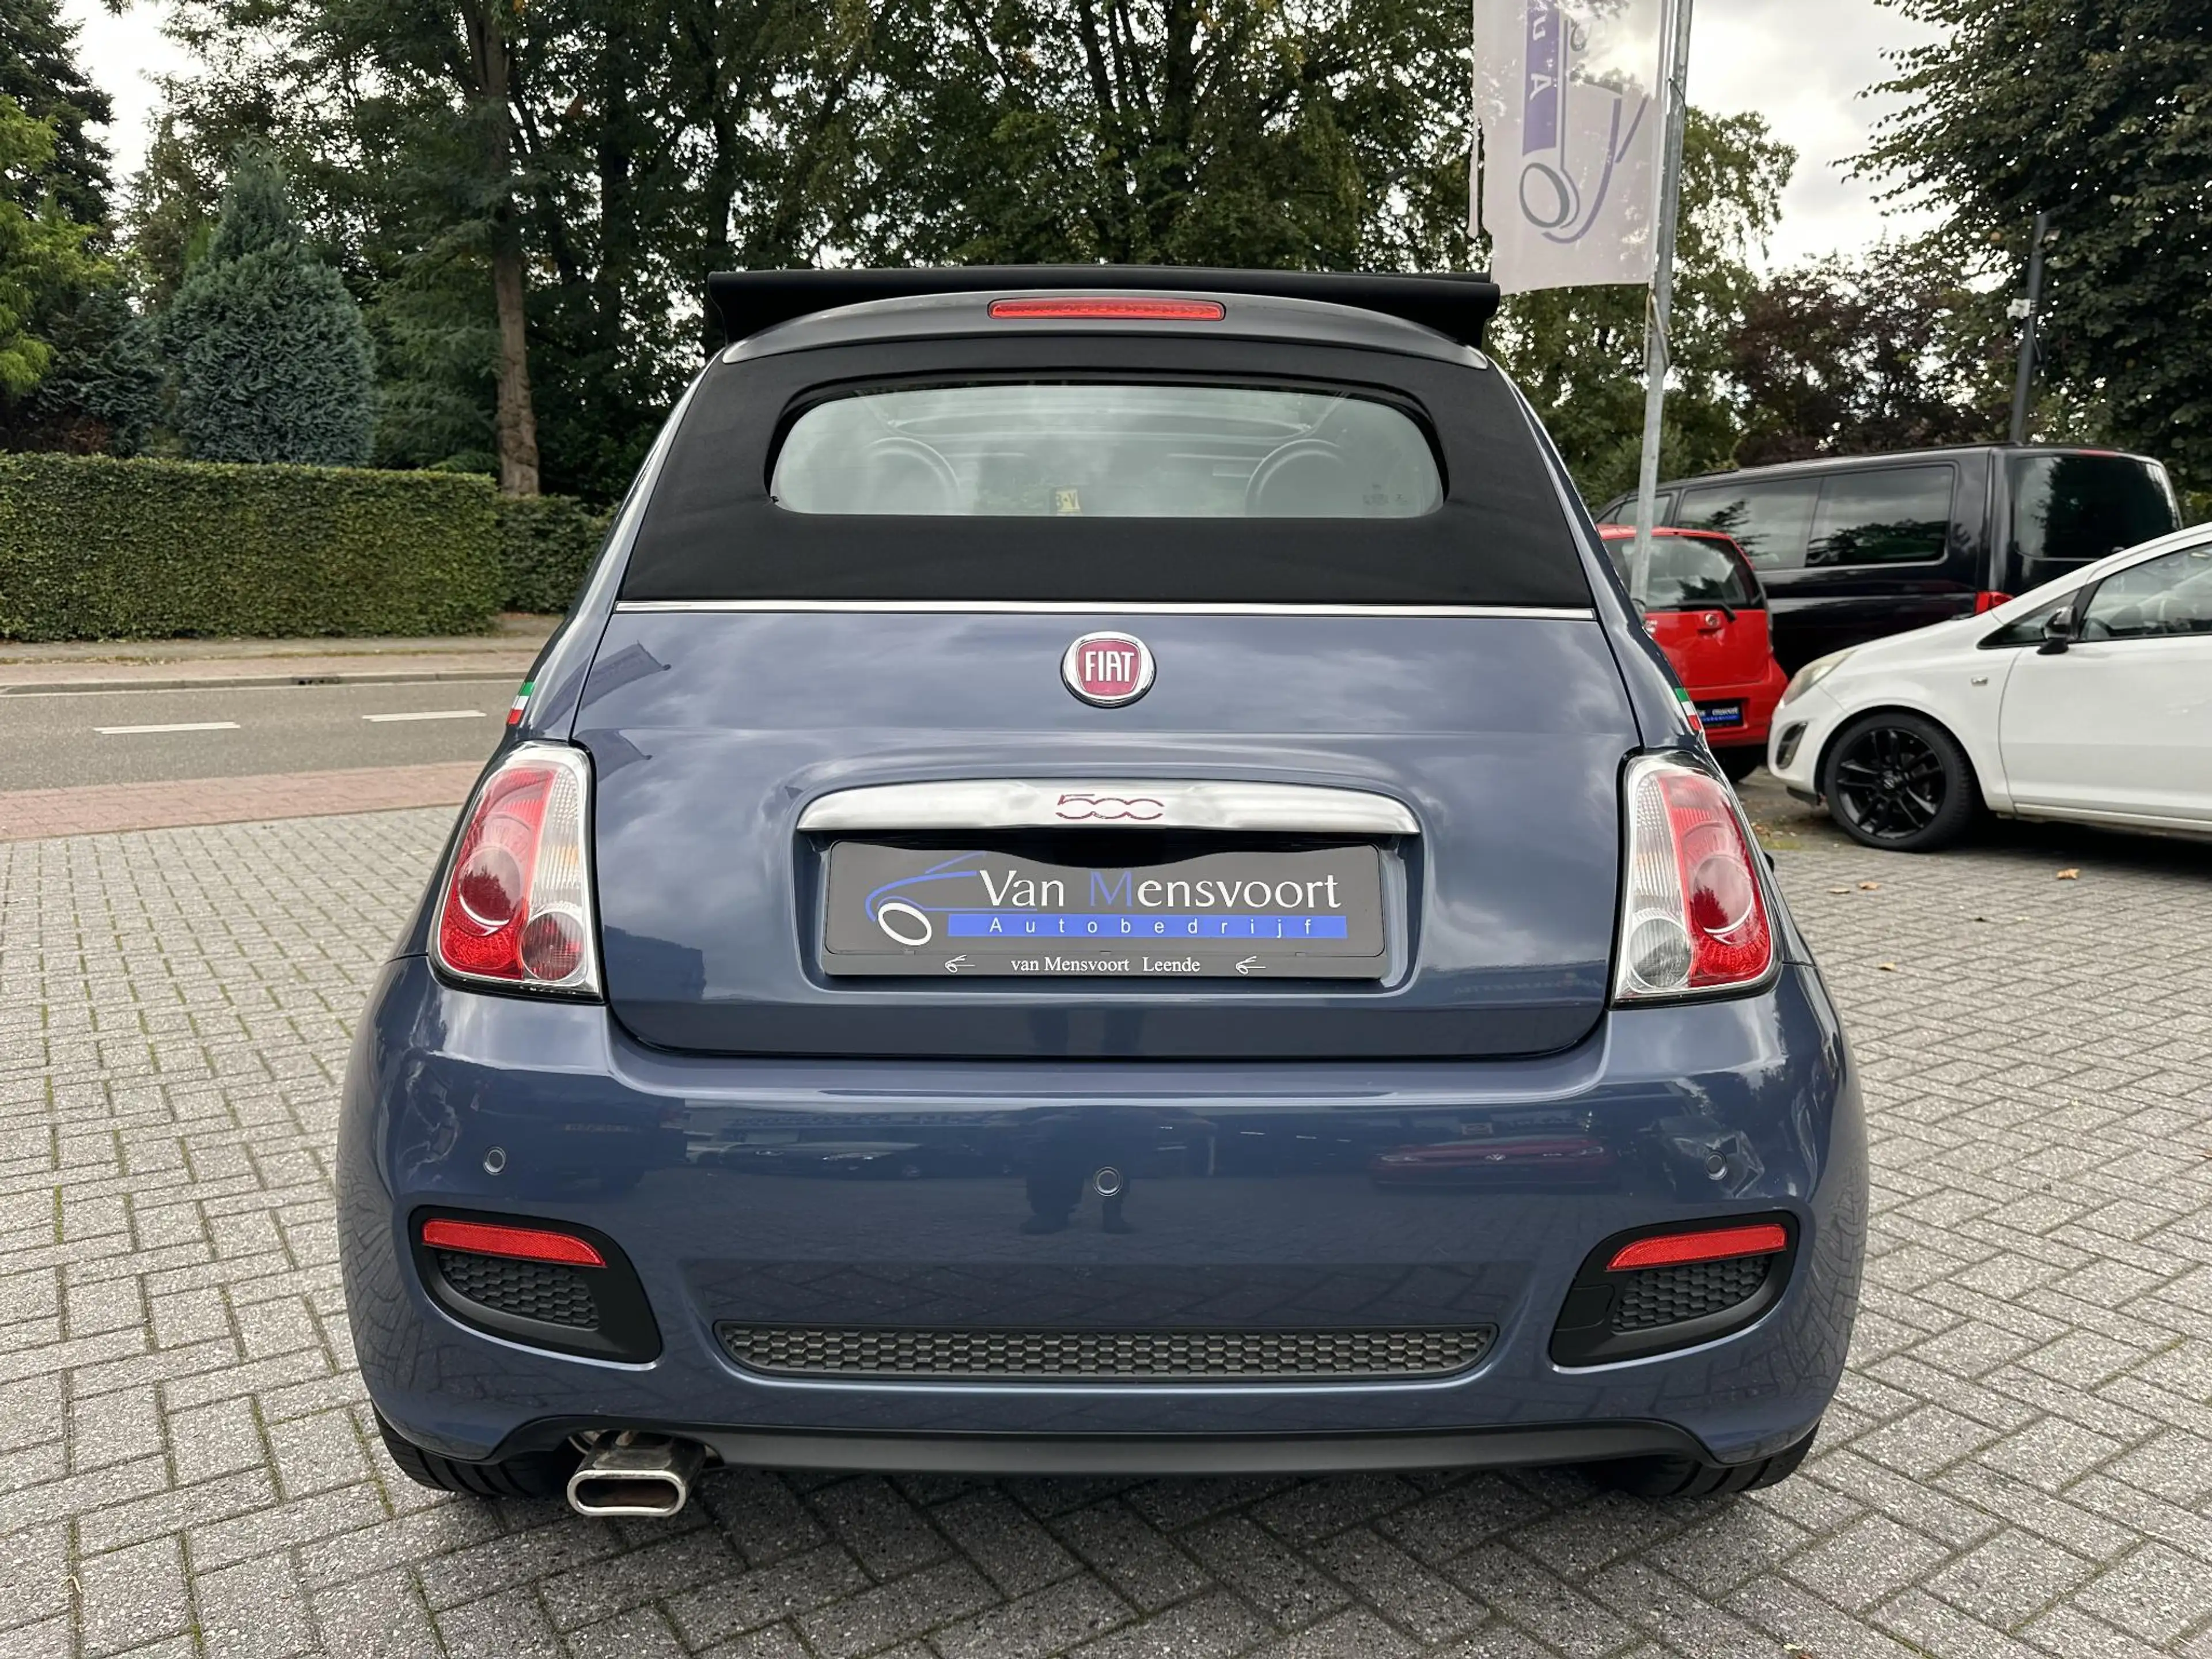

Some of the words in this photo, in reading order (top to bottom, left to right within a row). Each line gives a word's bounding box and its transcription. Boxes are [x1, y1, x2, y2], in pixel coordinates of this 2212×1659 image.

[1085, 650, 1135, 682] FIAT
[1055, 794, 1165, 820] 500
[979, 869, 1065, 907] Van
[1089, 870, 1342, 908] Mensvoort
[989, 916, 1312, 939] Autobedrijf
[1010, 960, 1039, 972] van
[1043, 956, 1130, 972] Mensvoort
[1142, 956, 1201, 973] Leende
